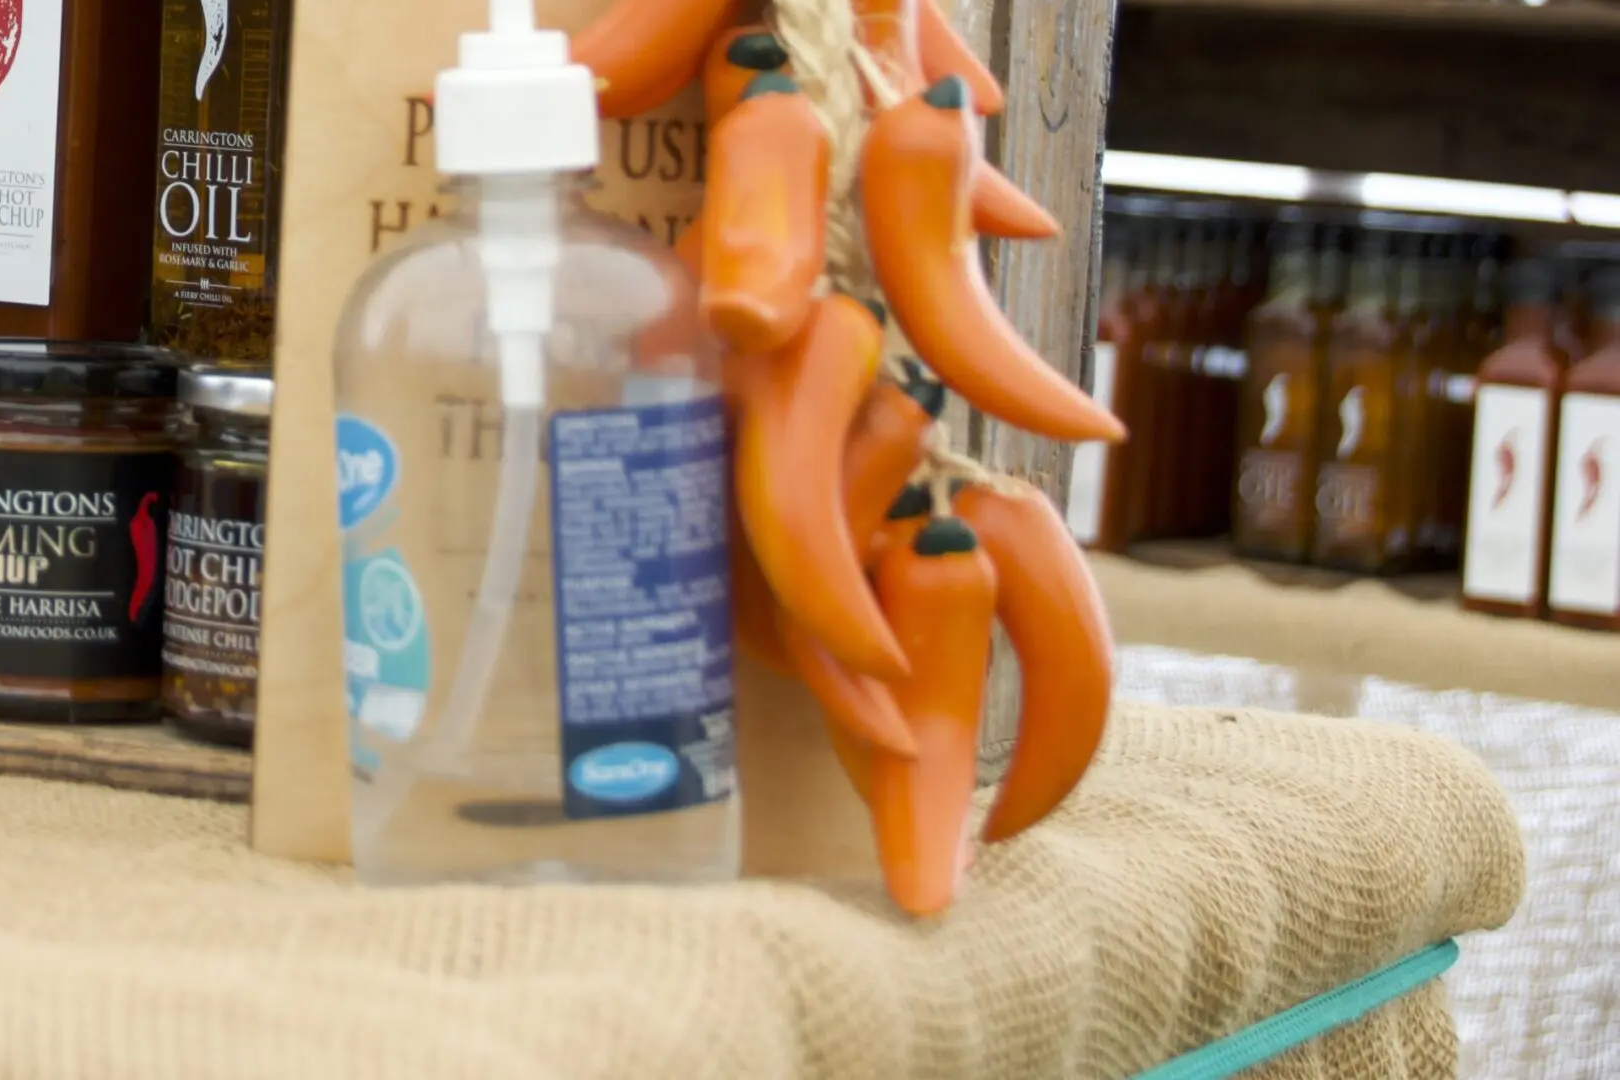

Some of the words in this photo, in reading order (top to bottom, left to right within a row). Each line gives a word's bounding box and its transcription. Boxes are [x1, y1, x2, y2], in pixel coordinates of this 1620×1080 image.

[163, 128, 254, 148] CARRINGTONS
[161, 150, 253, 185] CHILLI
[160, 181, 252, 243] OIL
[171, 242, 211, 256] INFUSED
[213, 245, 238, 257] WITH
[159, 252, 207, 268] ROSEMARY
[208, 258, 216, 269] &
[10, 596, 102, 619] HARRISA
